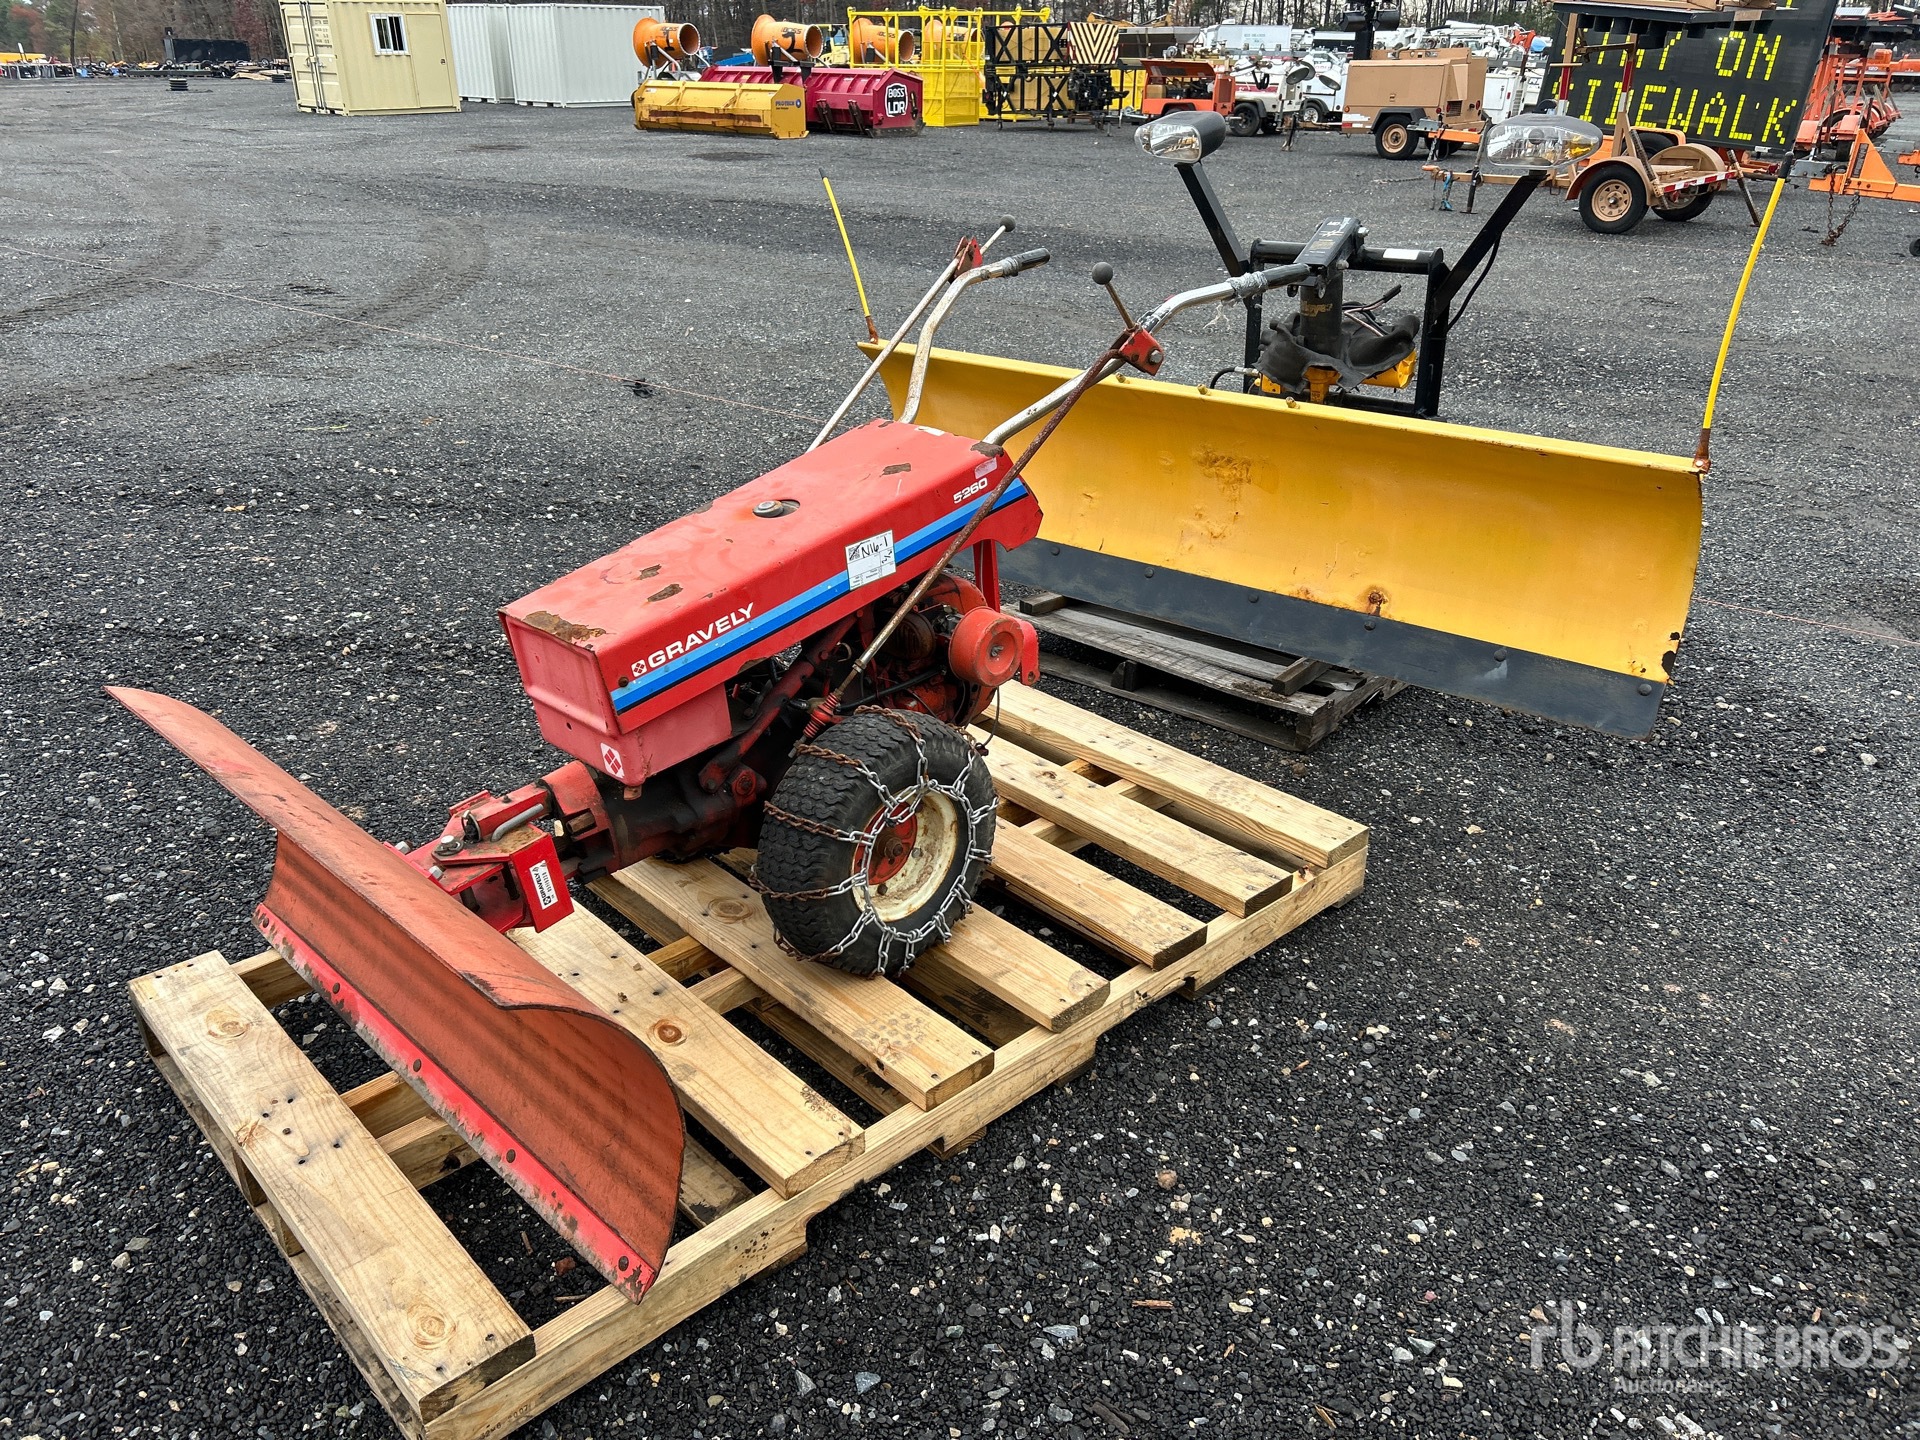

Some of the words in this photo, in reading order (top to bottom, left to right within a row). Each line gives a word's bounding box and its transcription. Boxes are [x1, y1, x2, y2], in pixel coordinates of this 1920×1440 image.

[1715, 31, 1782, 81] ON
[888, 88, 904, 98] BOSS
[888, 101, 905, 114] LDR
[953, 477, 988, 504] 5260
[861, 535, 888, 559] N16-1
[647, 602, 754, 668] GRAVELY
[534, 872, 547, 899] GRAVELY
